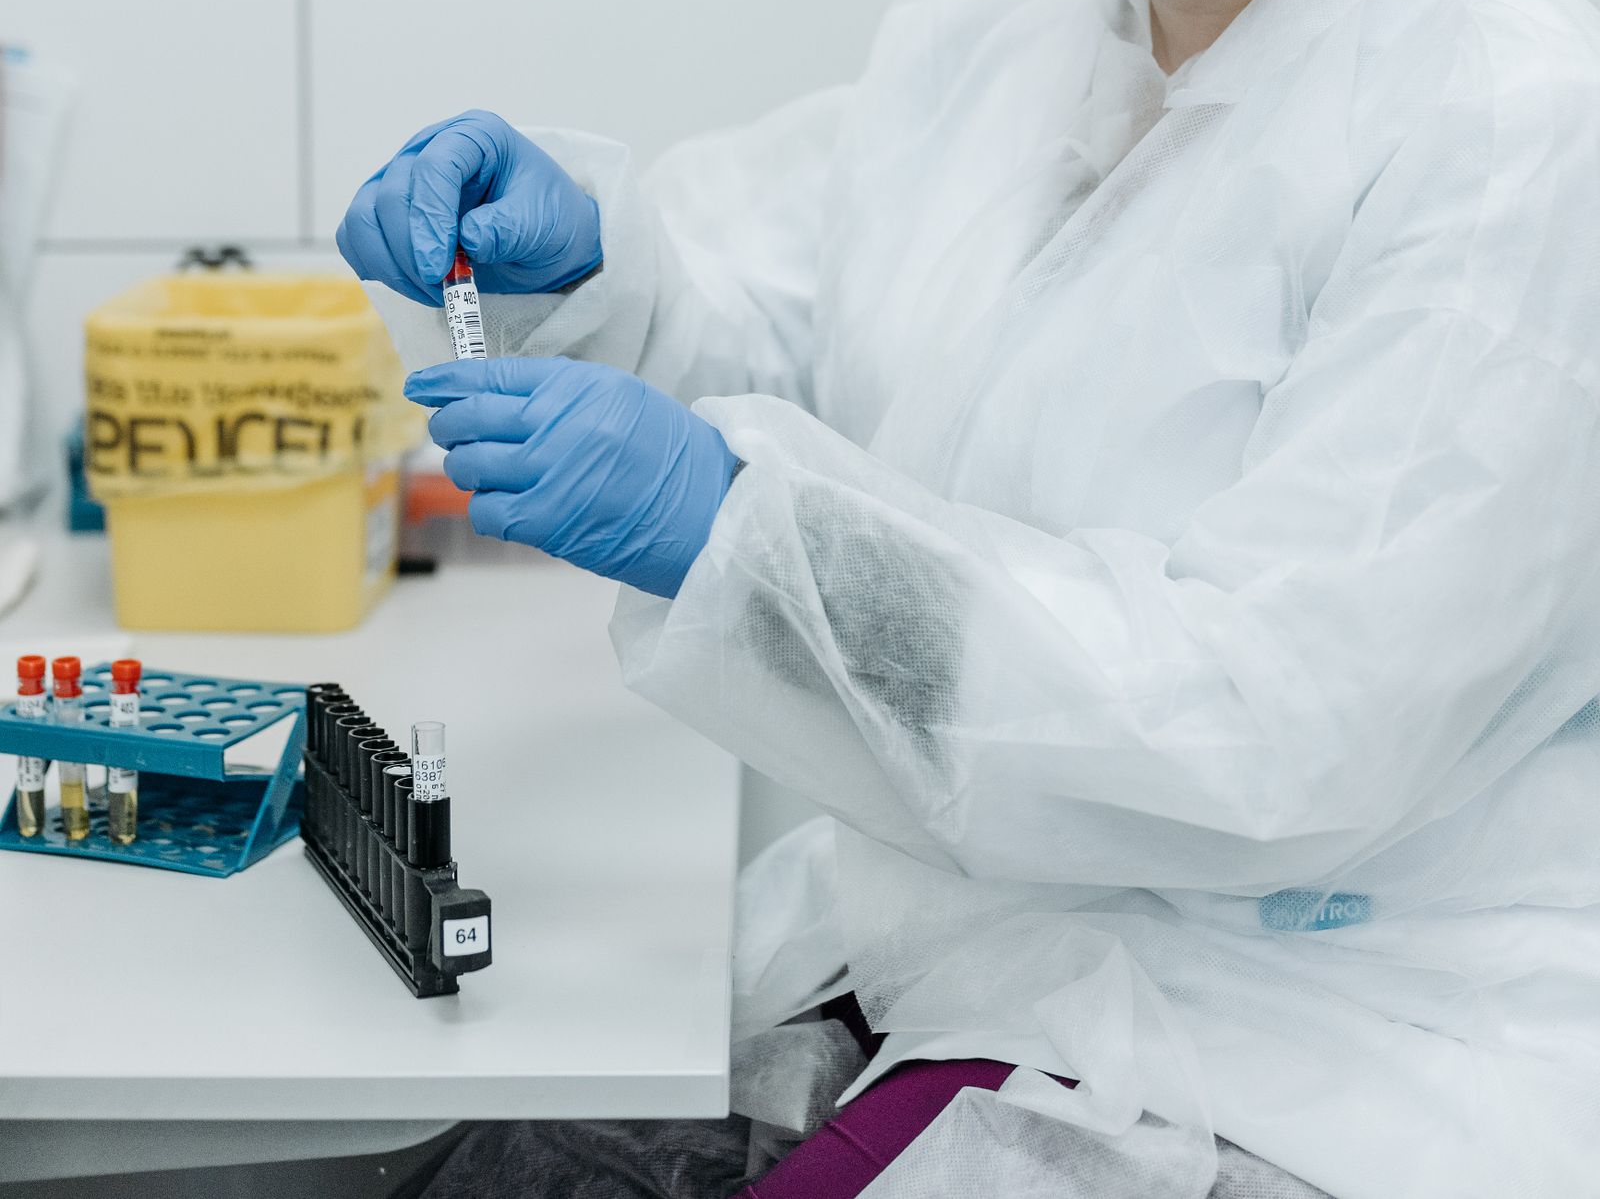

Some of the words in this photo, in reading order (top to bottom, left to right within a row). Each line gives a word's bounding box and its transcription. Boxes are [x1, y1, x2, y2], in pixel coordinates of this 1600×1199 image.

[454, 314, 468, 354] 27.05.21
[415, 771, 442, 781] 6387
[456, 927, 477, 944] 64
